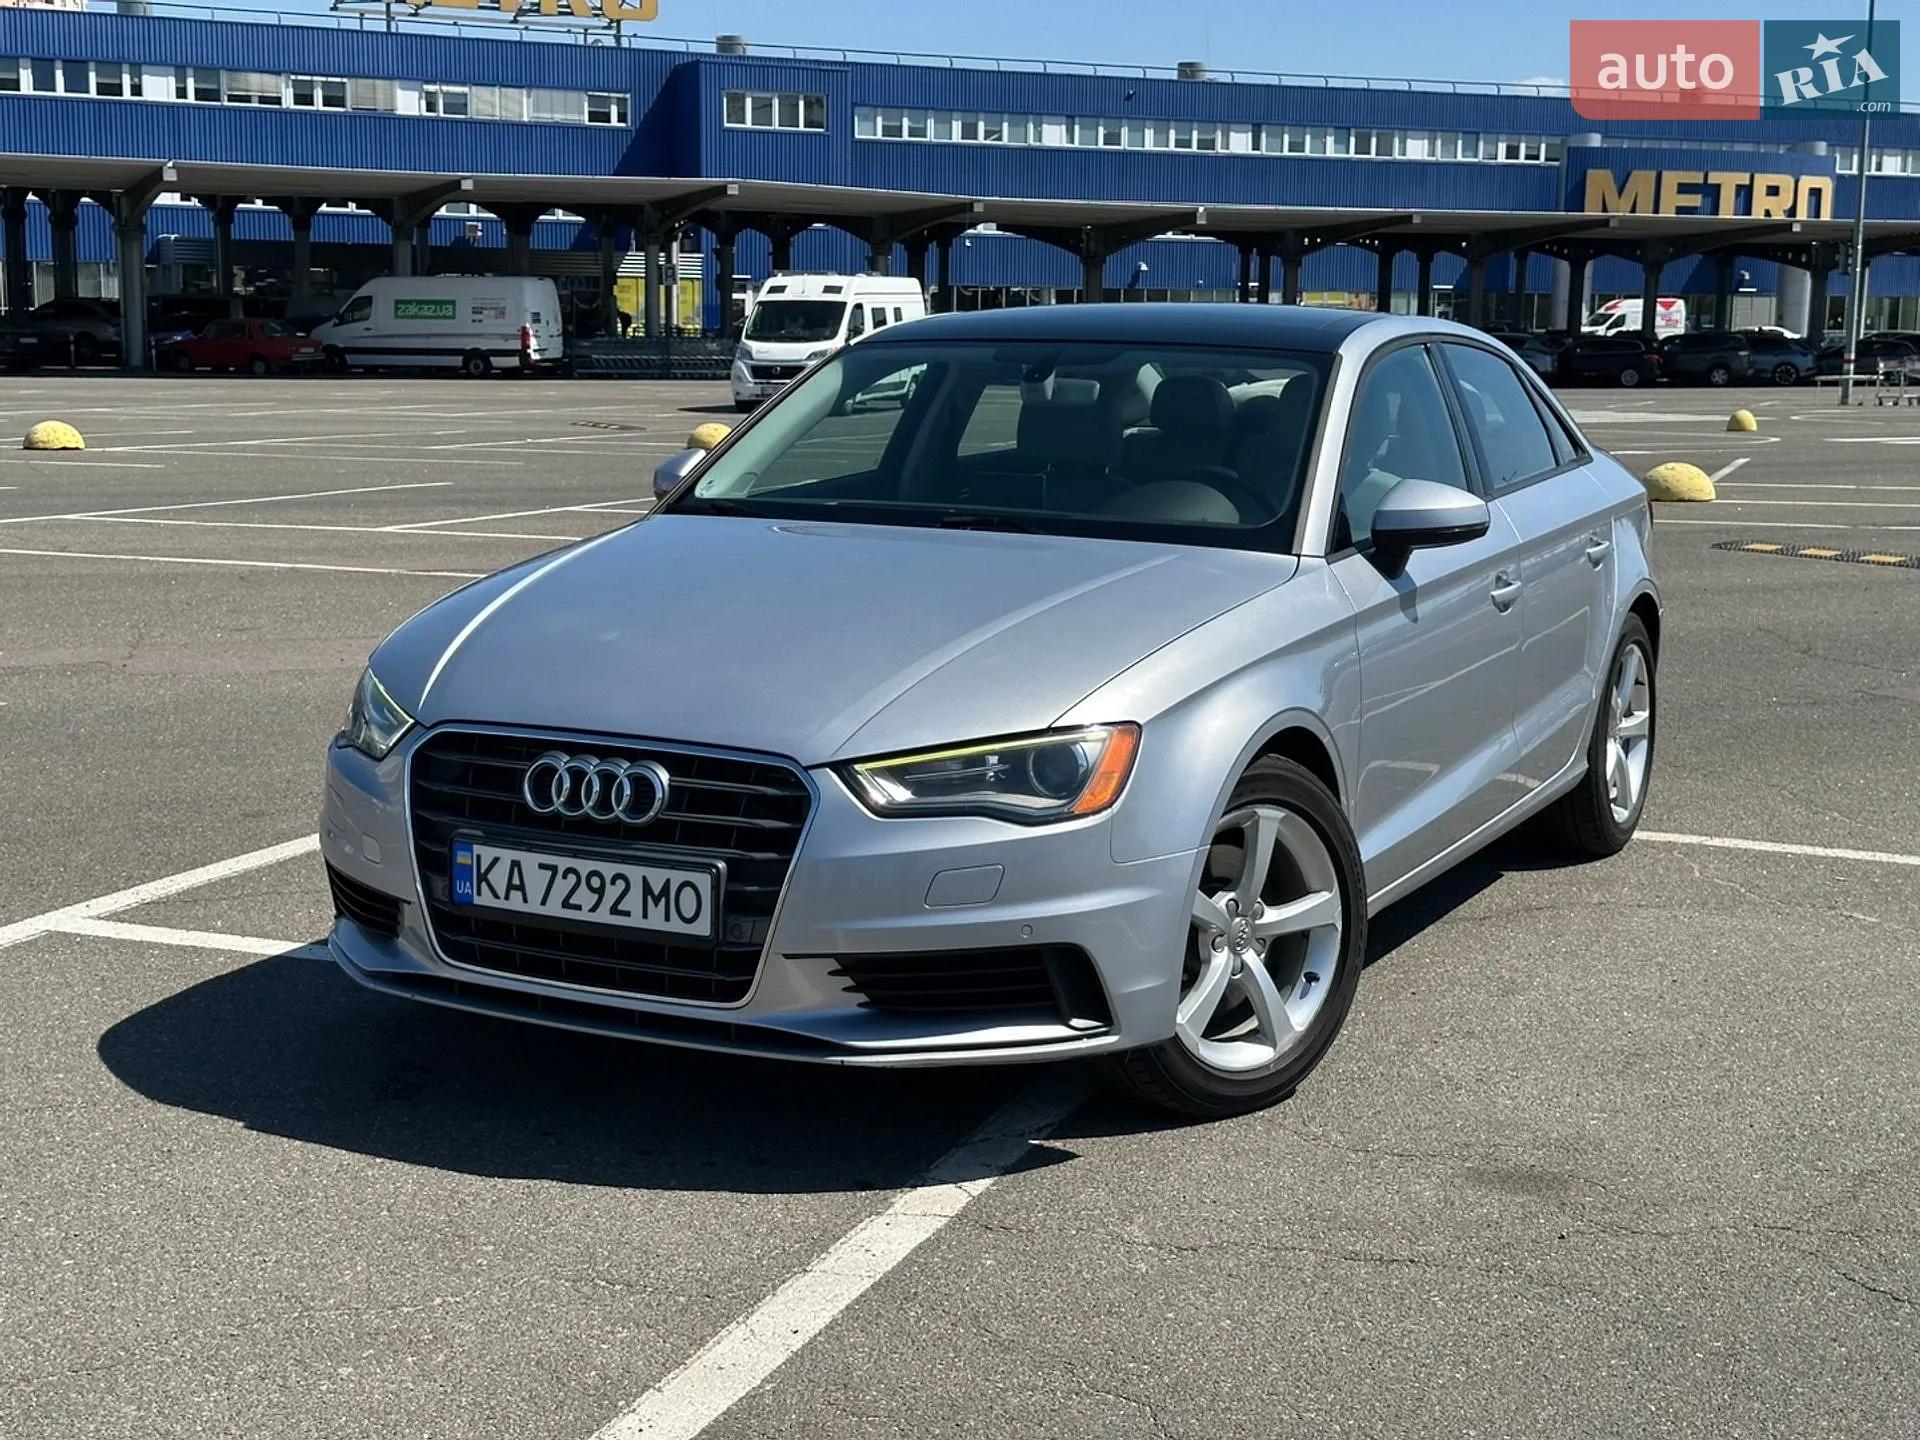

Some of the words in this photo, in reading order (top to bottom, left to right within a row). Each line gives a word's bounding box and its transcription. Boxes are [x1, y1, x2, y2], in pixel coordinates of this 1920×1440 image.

[1584, 168, 1834, 220] METRO
[456, 880, 473, 895] UA
[475, 853, 529, 904] KA
[537, 862, 632, 918] 7292
[641, 874, 702, 925] MO
